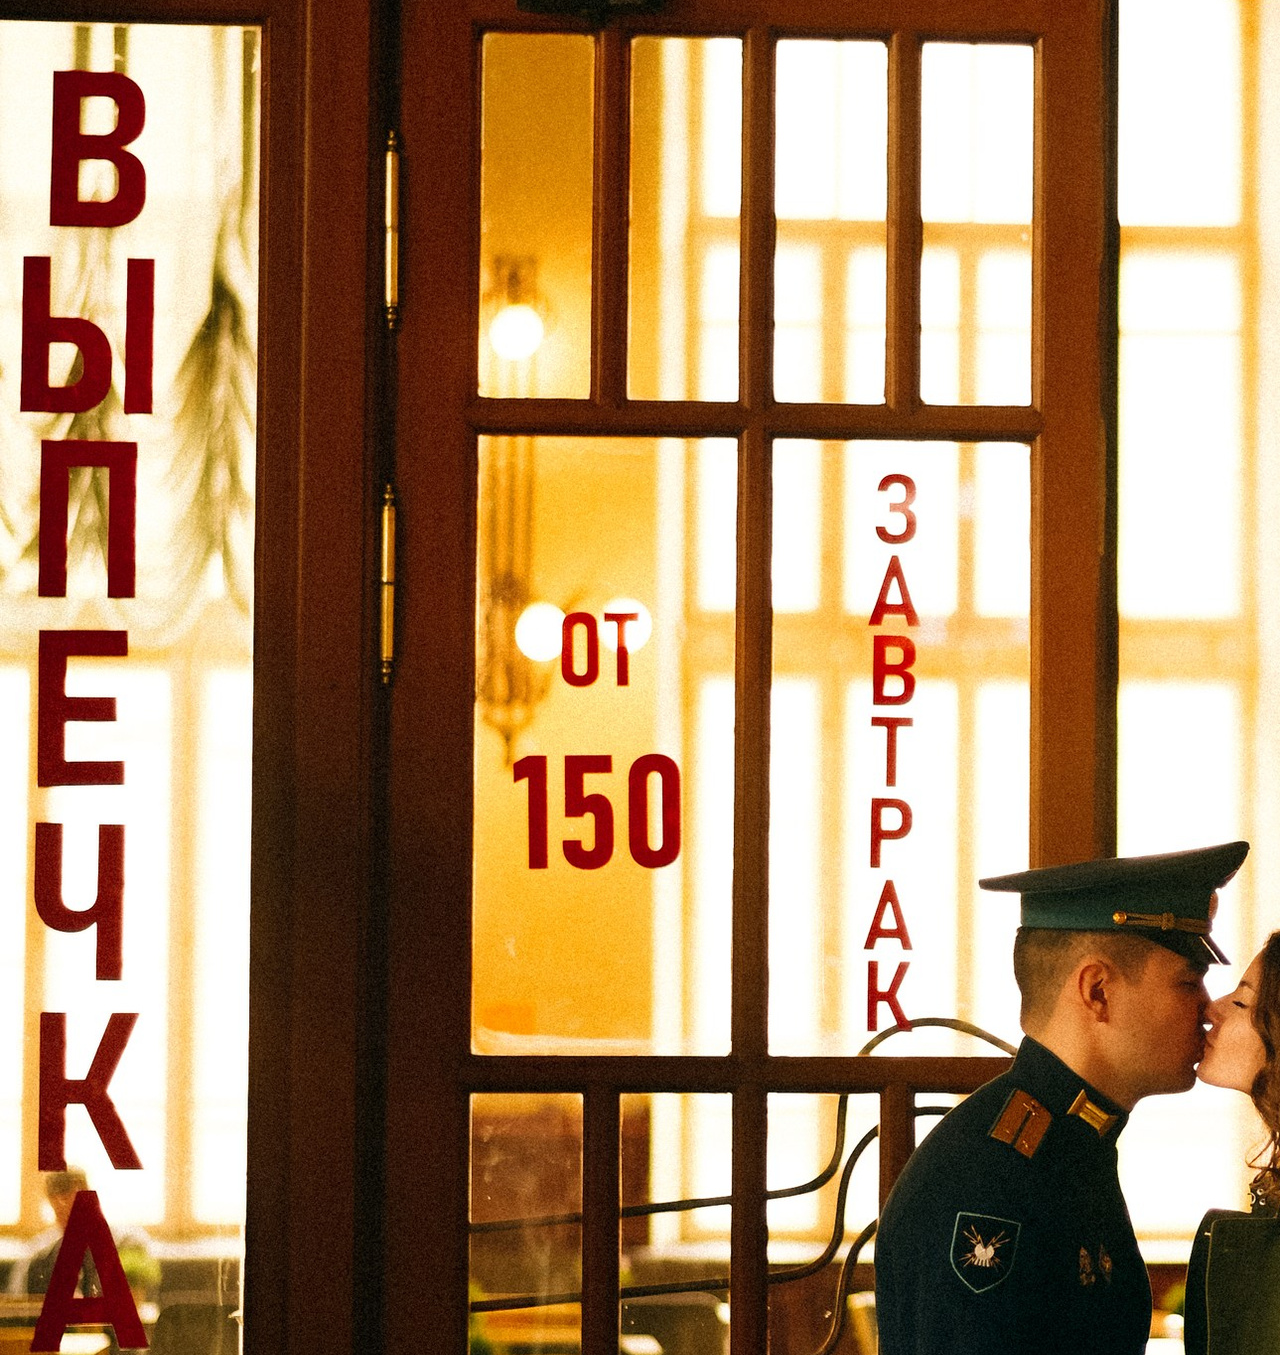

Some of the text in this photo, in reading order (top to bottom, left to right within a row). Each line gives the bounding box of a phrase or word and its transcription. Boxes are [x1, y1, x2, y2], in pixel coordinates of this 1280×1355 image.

[20, 70, 155, 1352] ВЫПЕЧКА
[512, 752, 682, 870] 150
[560, 611, 640, 687] ОТ
[863, 473, 920, 1032] ЗАВТРАК
